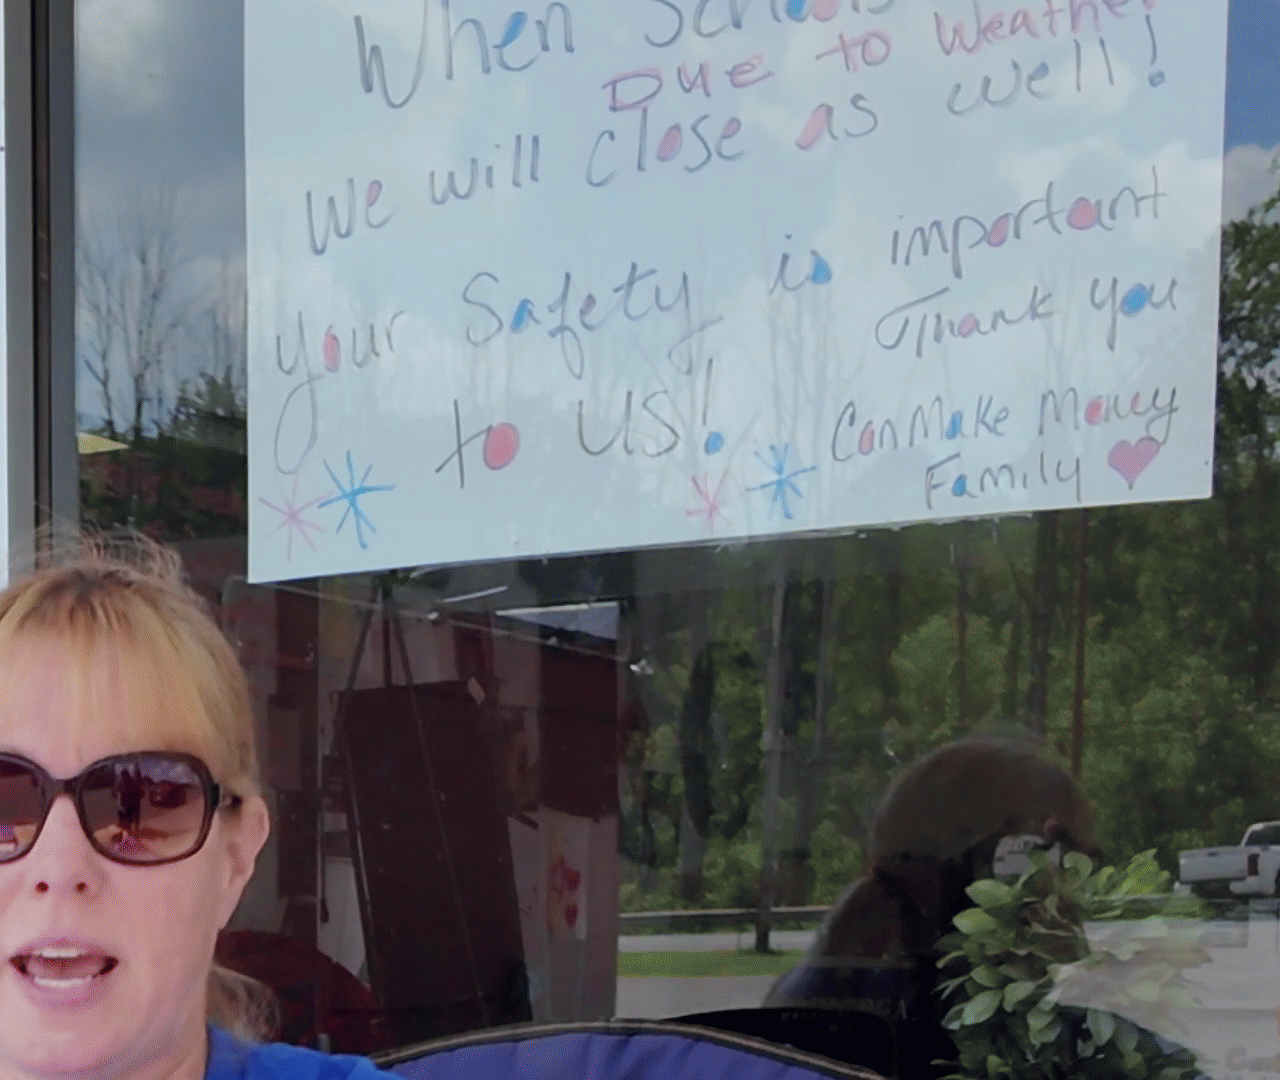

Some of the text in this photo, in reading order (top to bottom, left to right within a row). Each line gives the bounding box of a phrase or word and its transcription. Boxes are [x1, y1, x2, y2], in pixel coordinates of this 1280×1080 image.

[816, 30, 891, 72] to
[429, 134, 540, 206] will
[795, 93, 878, 151] as
[463, 262, 724, 380] Safety
[891, 164, 1167, 280] important
[875, 276, 1178, 359] Thank you
[435, 400, 520, 489] to
[926, 452, 1083, 510] Family
